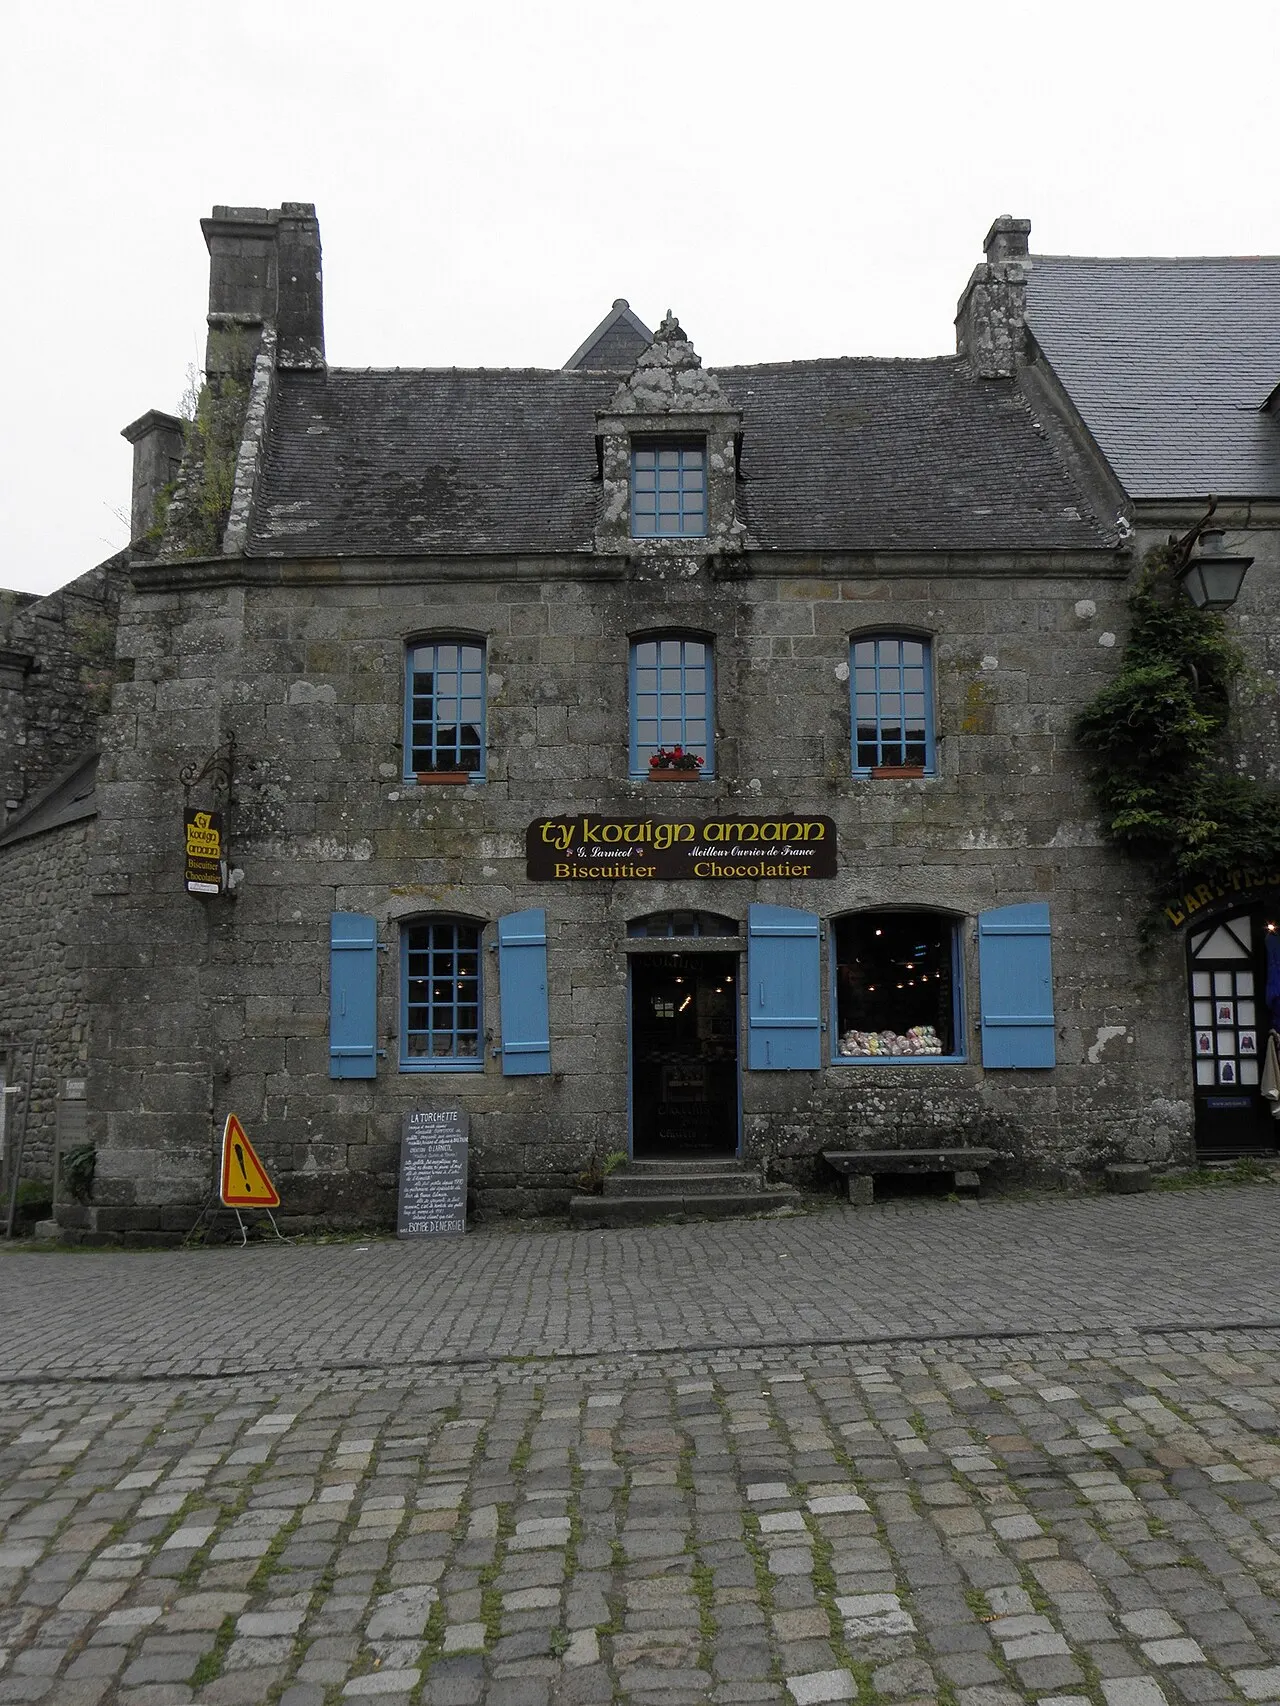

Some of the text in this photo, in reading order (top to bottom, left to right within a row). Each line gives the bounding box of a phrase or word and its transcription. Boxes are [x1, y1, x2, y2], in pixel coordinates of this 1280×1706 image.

[539, 821, 576, 850] ty
[703, 822, 825, 842] amann
[576, 846, 634, 858] G. Larnicol
[687, 844, 817, 857] Meilleur Ouvrier de France
[188, 858, 219, 871] Biscuitier
[554, 862, 656, 879] Biscuitier
[694, 861, 811, 877] Chocolatier
[185, 870, 221, 883] Chocolatier
[410, 1111, 458, 1123] LA TORCHETTE
